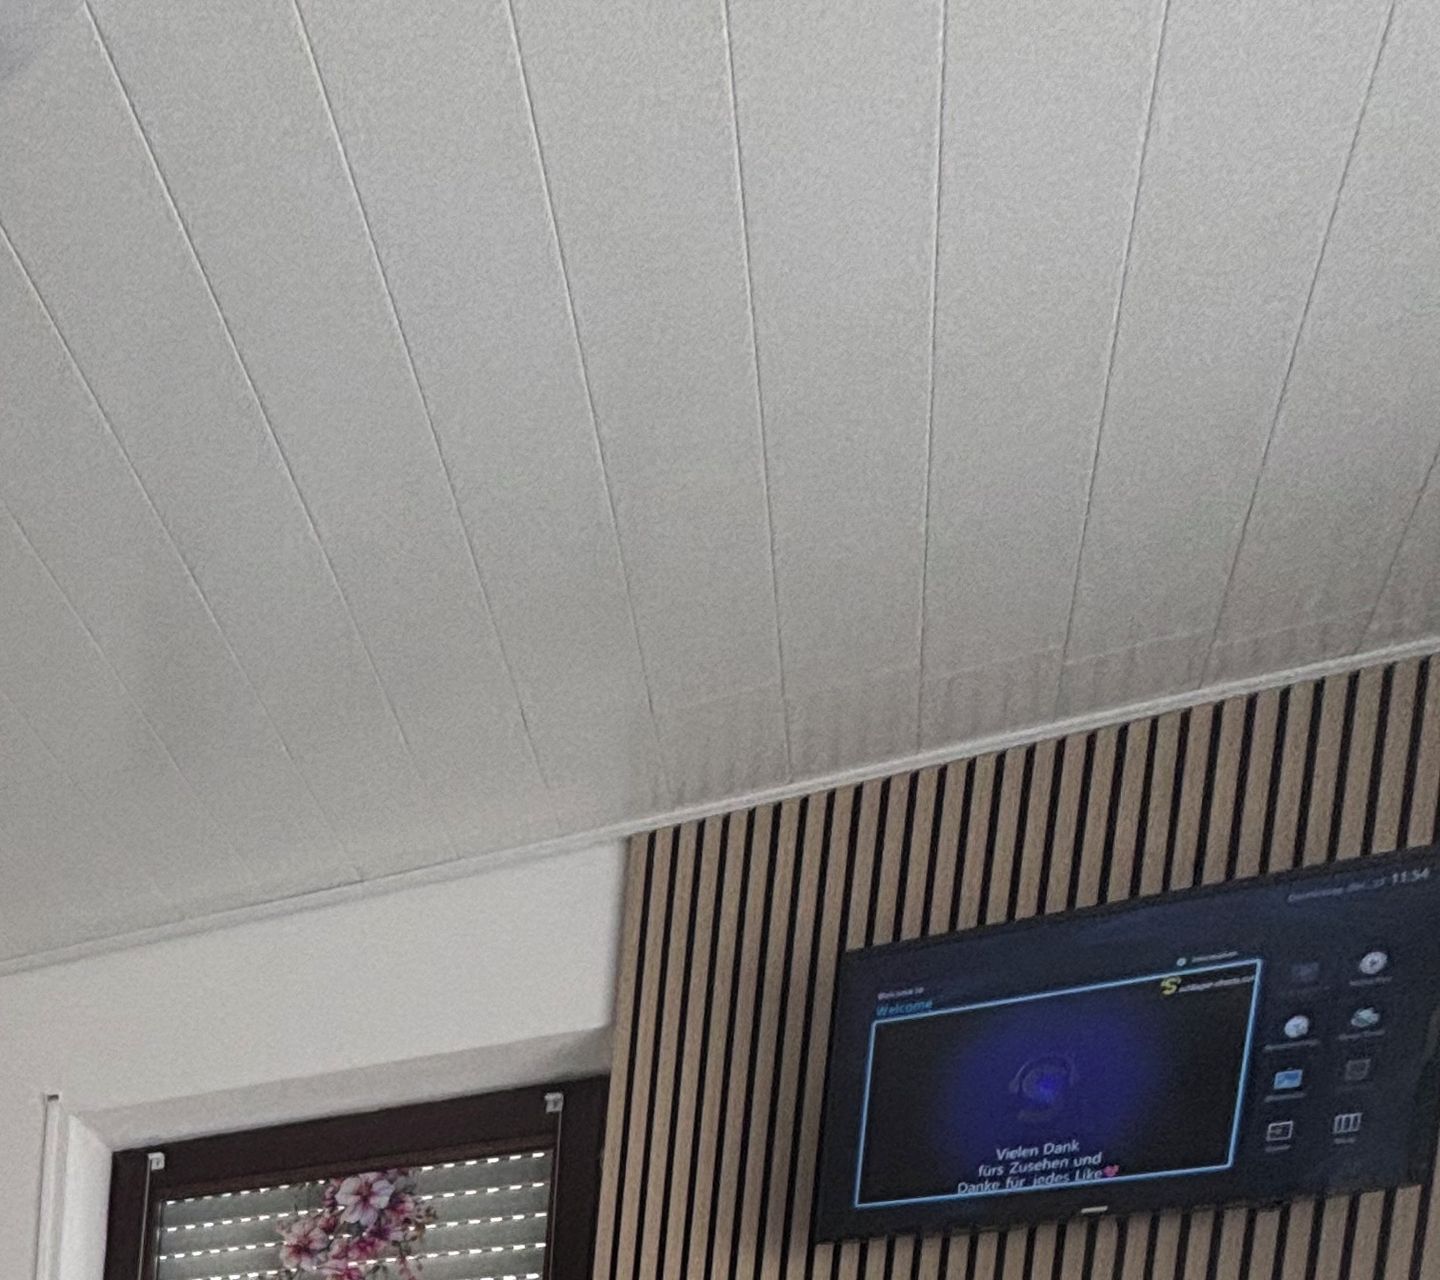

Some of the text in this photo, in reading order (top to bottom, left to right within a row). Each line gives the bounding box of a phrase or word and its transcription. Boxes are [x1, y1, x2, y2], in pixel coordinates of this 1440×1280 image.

[876, 999, 933, 1017] Welcome
[996, 1139, 1080, 1161] Vielen Dank
[978, 1152, 1103, 1177] fürs Zusehen und
[957, 1181, 1000, 1194] Danke
[1005, 1176, 1026, 1190] für
[1075, 1168, 1103, 1182] Like
